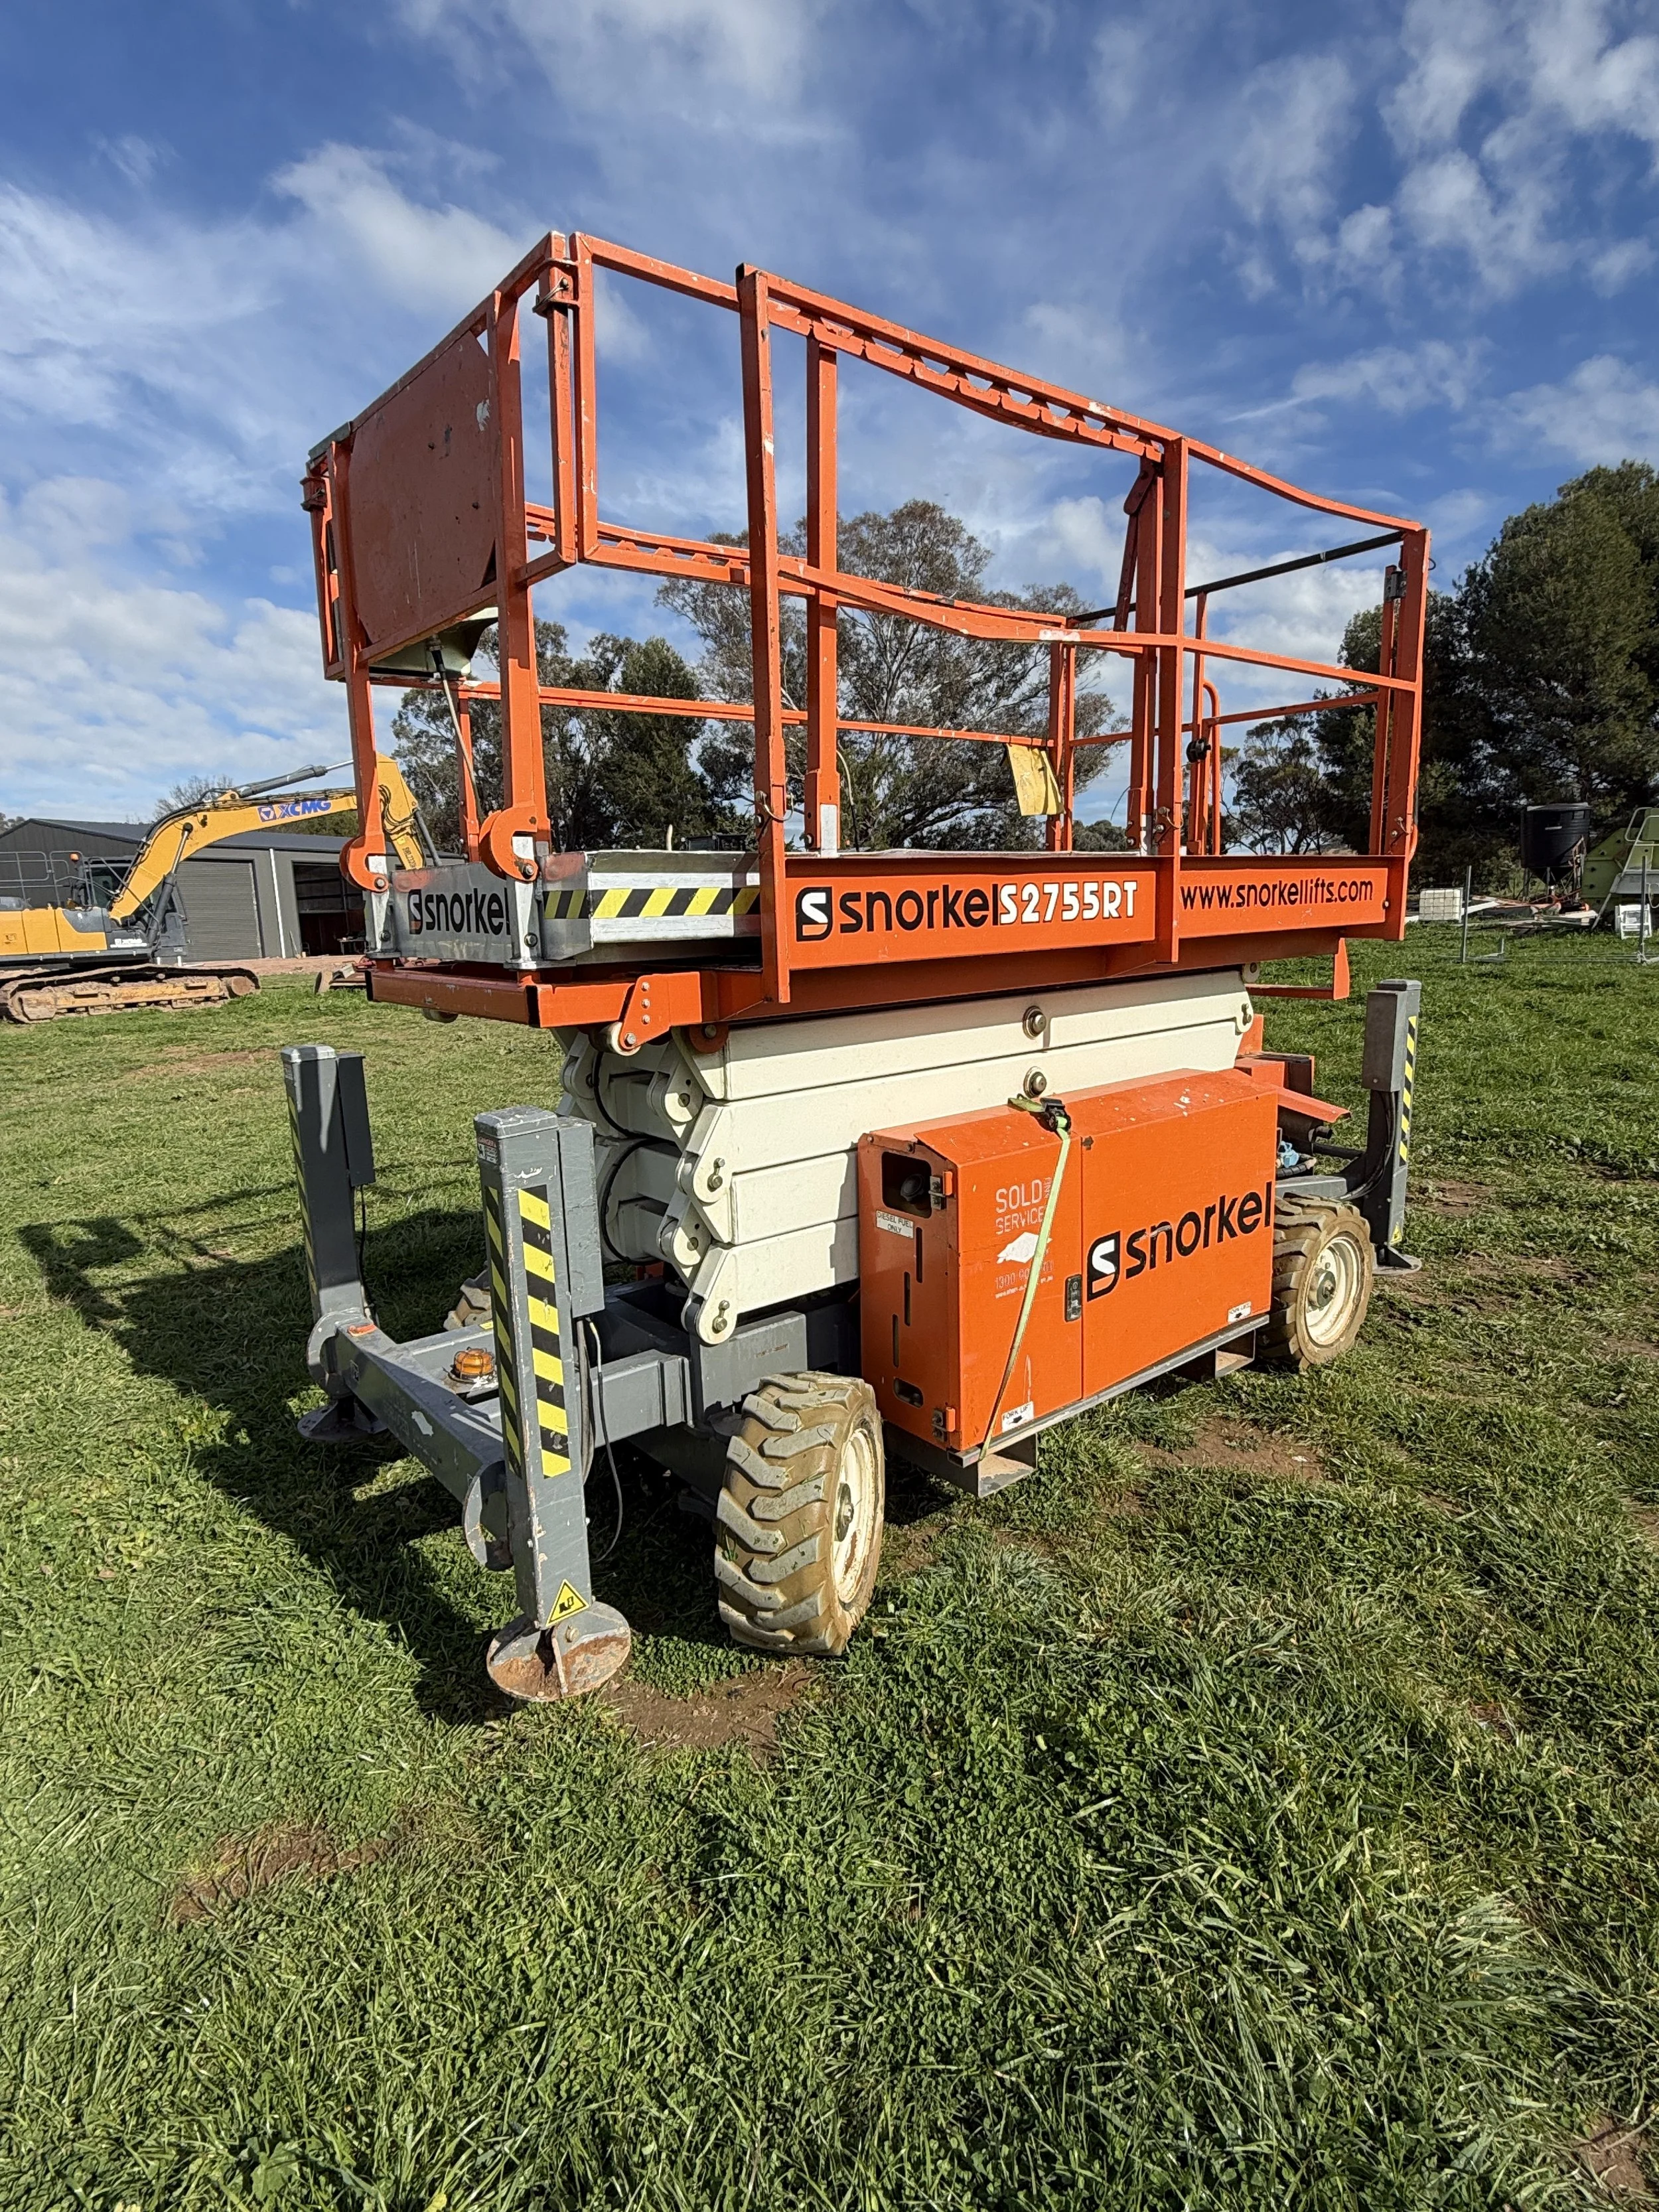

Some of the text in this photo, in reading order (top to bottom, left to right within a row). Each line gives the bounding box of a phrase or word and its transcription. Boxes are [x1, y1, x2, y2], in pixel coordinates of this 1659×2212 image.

[277, 798, 331, 819] XCMG
[839, 883, 999, 934] snorkel
[999, 880, 1139, 925] S2755RT
[1180, 877, 1374, 910] www.snorkellifts.com
[424, 887, 511, 936] snorkel
[995, 1179, 1043, 1214] SOLD
[877, 1211, 913, 1228] DIESEL FUEL
[887, 1223, 902, 1233] ONLY
[1125, 1181, 1272, 1280] snorkel
